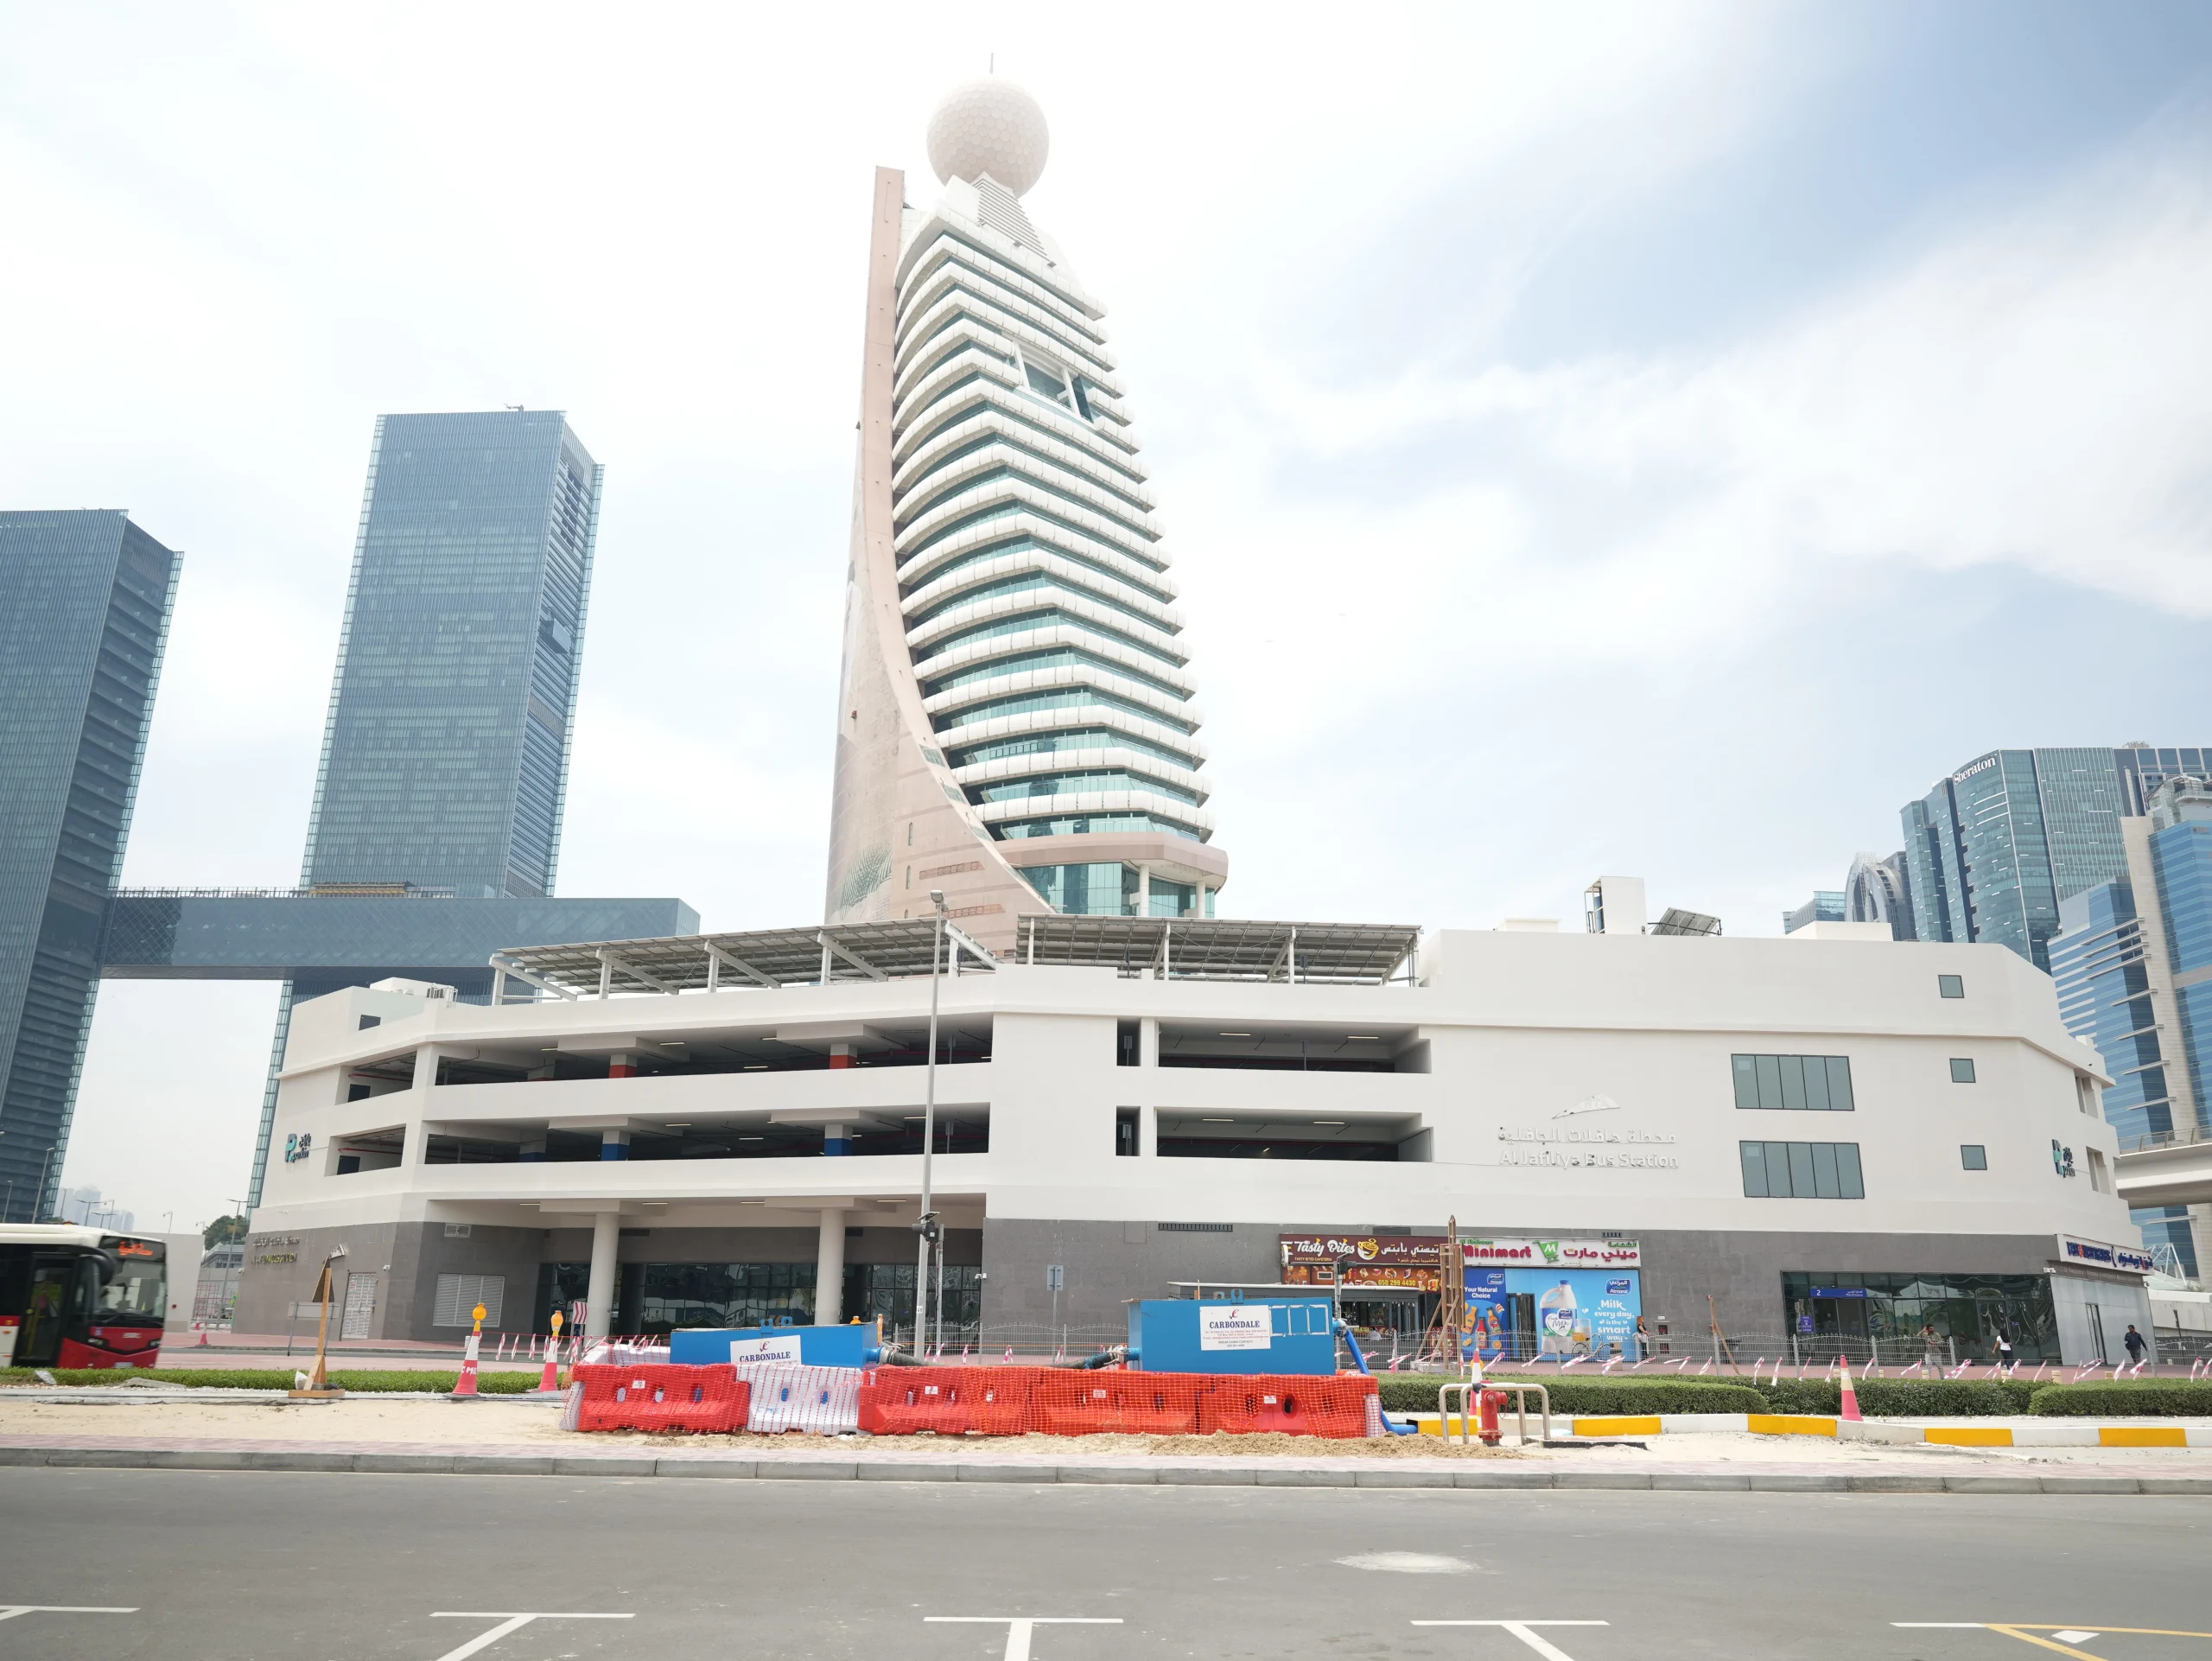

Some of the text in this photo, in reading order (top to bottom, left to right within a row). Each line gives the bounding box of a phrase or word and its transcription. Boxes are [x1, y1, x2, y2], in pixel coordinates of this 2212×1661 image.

[1954, 757, 1997, 786] Sheraton
[1568, 1129, 1622, 1143] حافلات
[1627, 1129, 1677, 1143] محطة
[1499, 1150, 1679, 1169] Al Jafiliya Bus Station
[1294, 1238, 1356, 1256] Tasty Bites
[1463, 1244, 1532, 1257] Minimart
[1600, 1300, 1627, 1311] Milk
[1594, 1310, 1635, 1320] every day,
[1209, 1321, 1261, 1329] CARBONDALE
[740, 1351, 791, 1363] CARBONDALE
